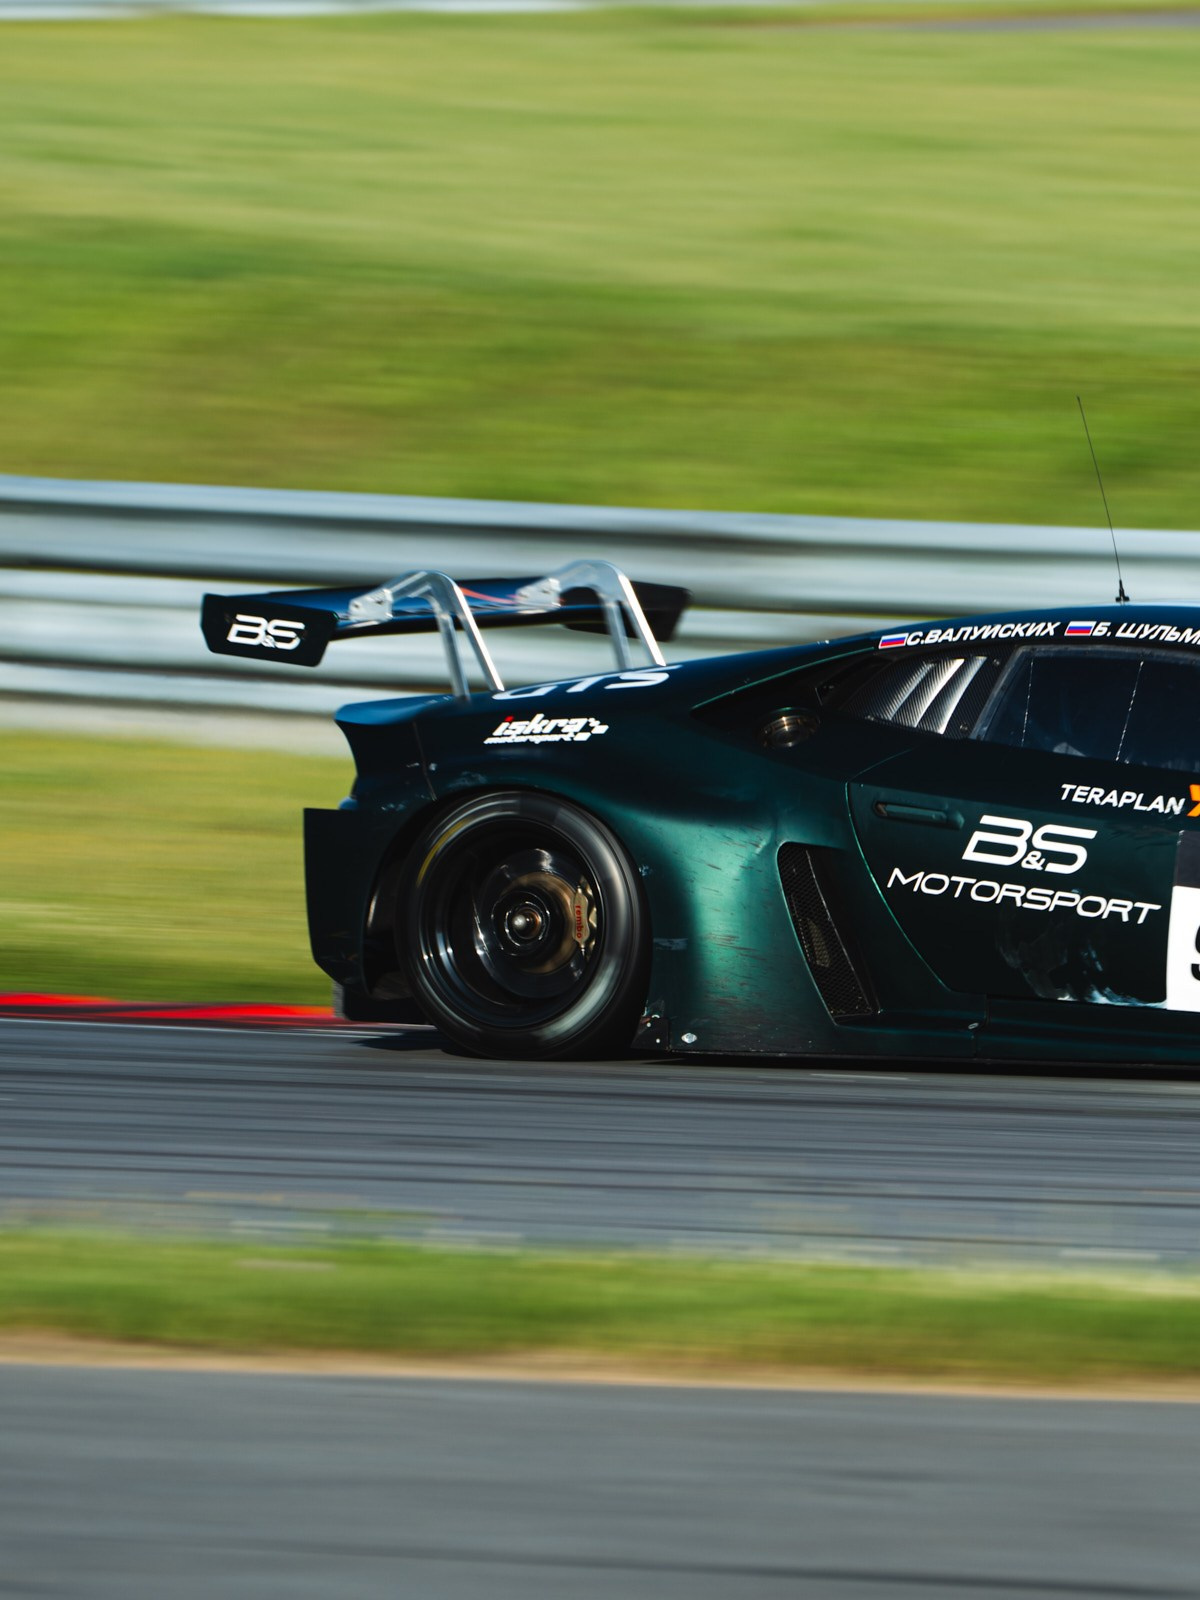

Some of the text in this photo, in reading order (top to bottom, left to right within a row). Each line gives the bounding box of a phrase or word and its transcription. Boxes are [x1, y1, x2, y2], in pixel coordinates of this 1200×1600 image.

[1091, 621, 1112, 637] Б.
[1061, 783, 1185, 815] TERAPLAN
[961, 814, 1098, 875] B&S
[886, 867, 1162, 925] MOTORSPORT
[574, 904, 584, 939] rembo
